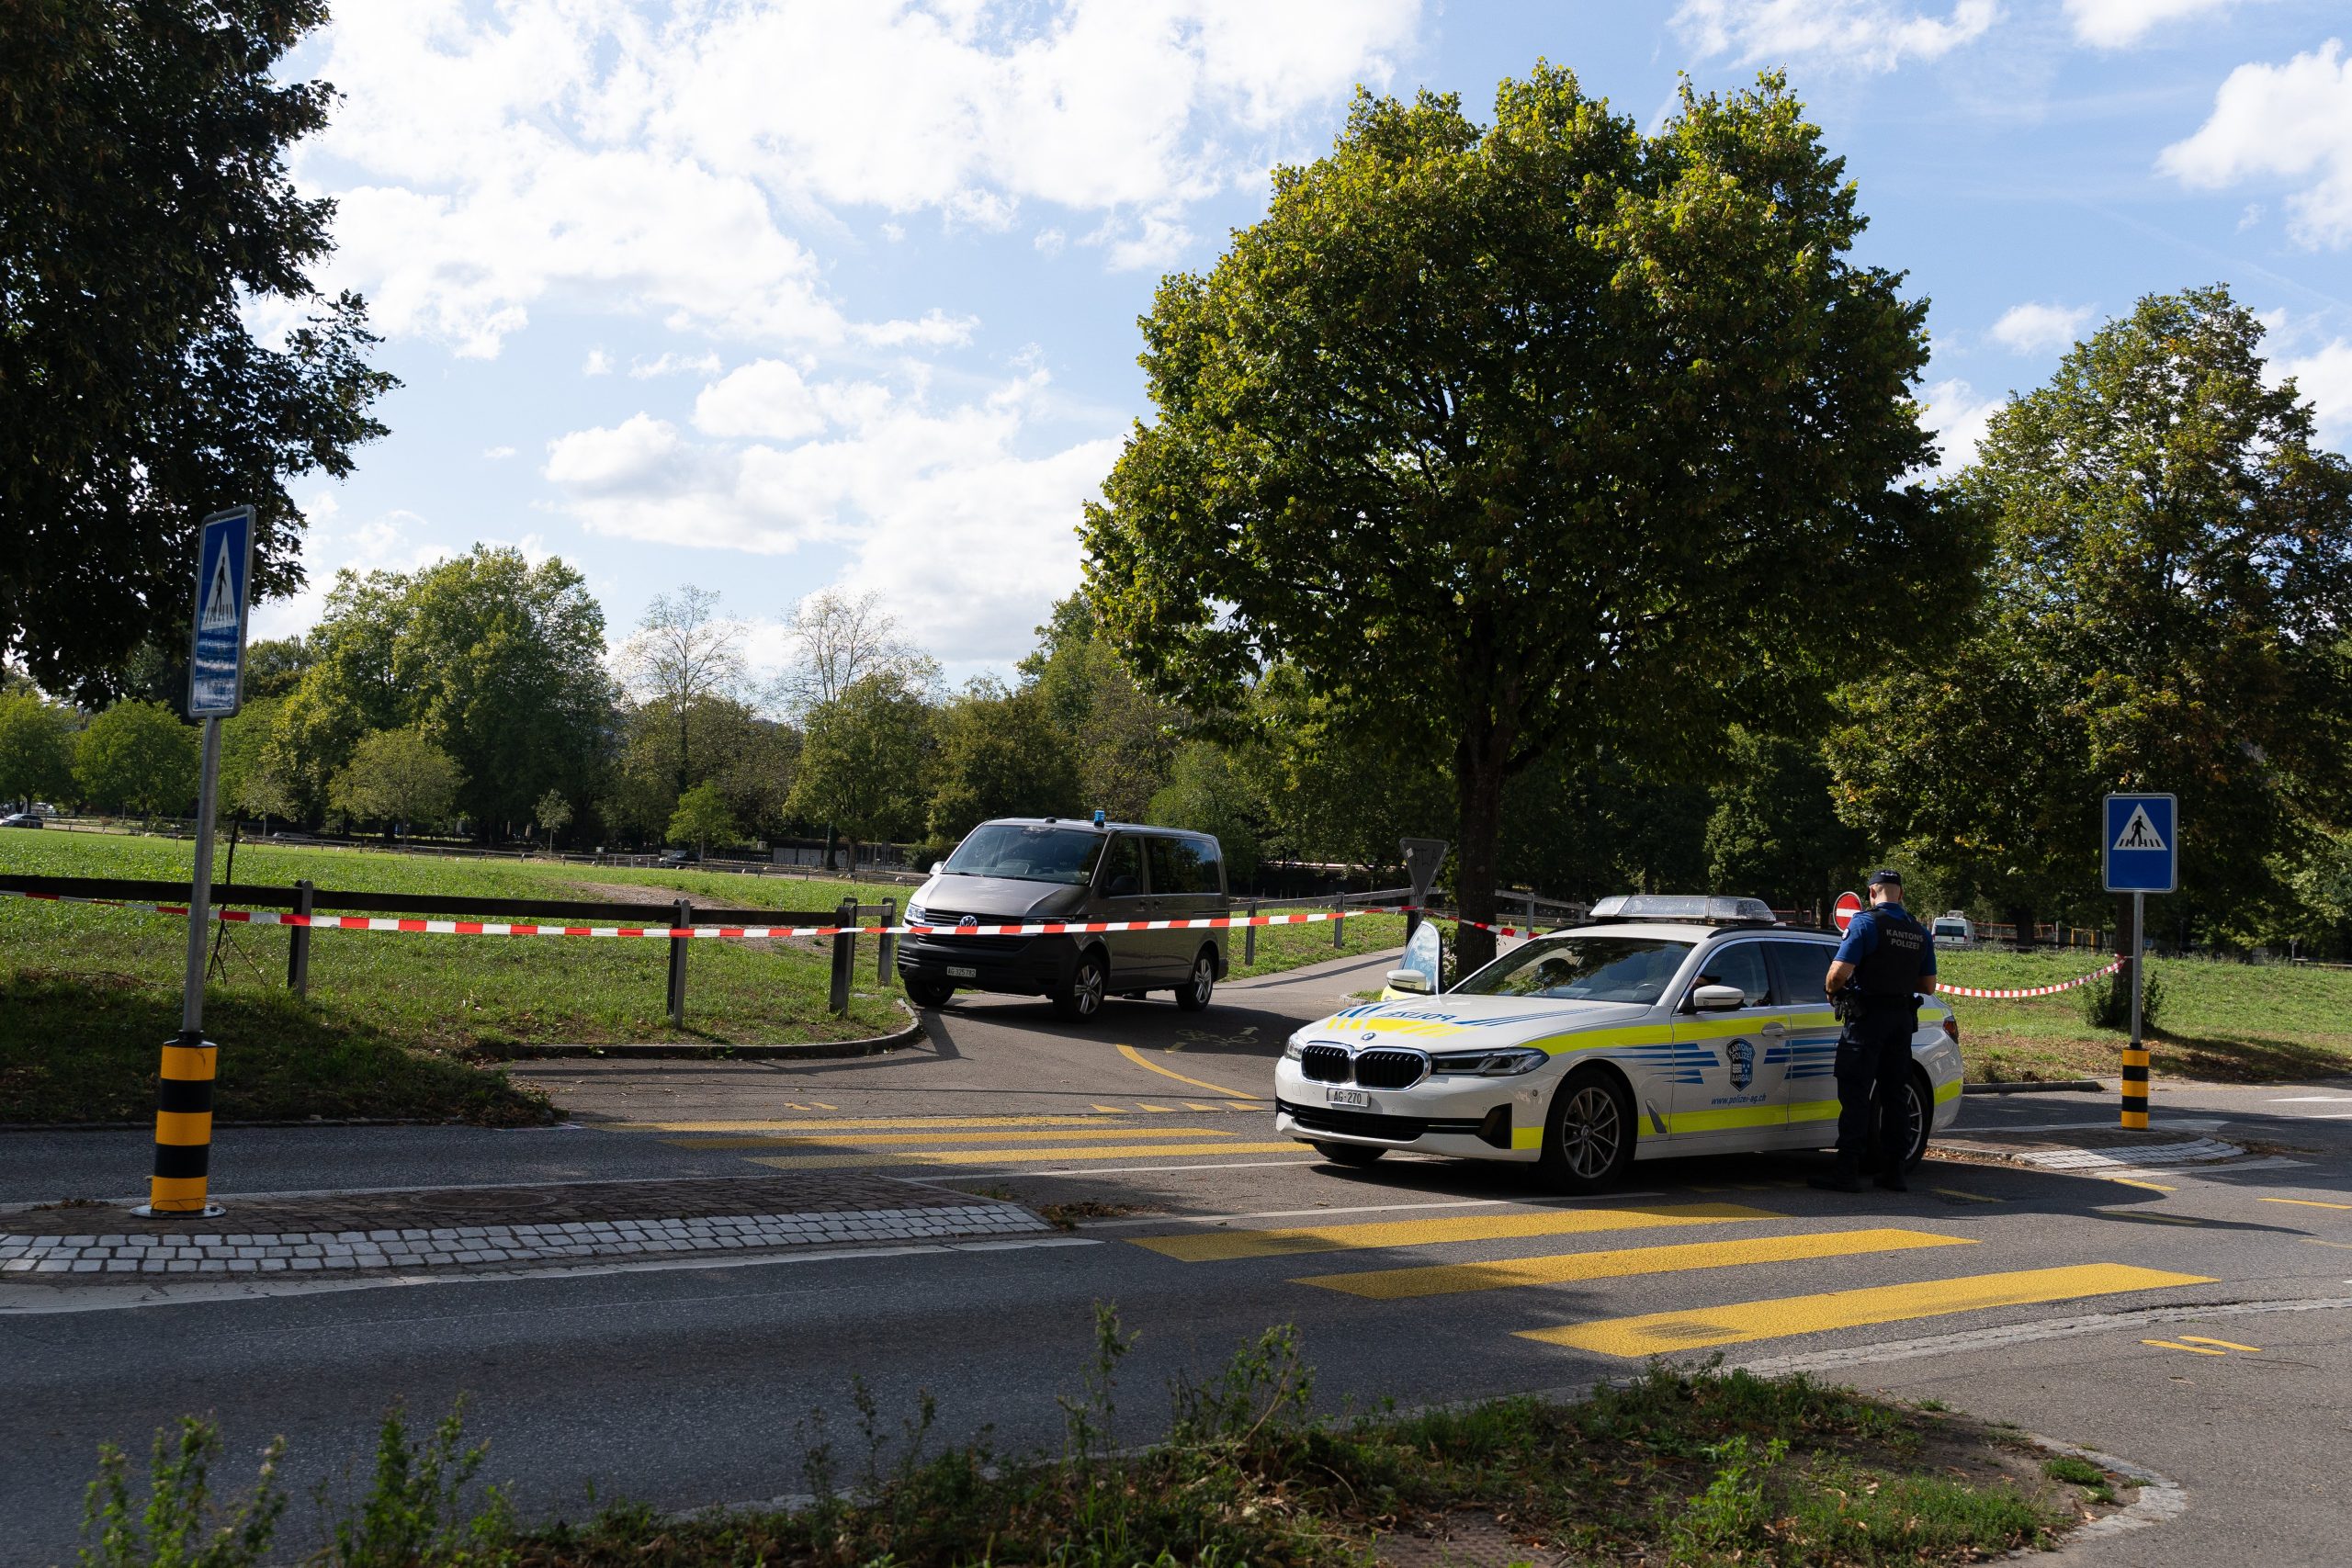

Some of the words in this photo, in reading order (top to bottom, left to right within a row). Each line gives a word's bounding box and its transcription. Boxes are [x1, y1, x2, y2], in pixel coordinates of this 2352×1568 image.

[1886, 929, 1923, 942] KANTONS
[1891, 938, 1919, 949] POLIZEI
[1728, 1043, 1752, 1055] KANTONS
[1732, 1052, 1752, 1062] POLIZEI
[1732, 1074, 1751, 1082] AARGAU
[1711, 1093, 1767, 1106] www.polizei-ag.ch
